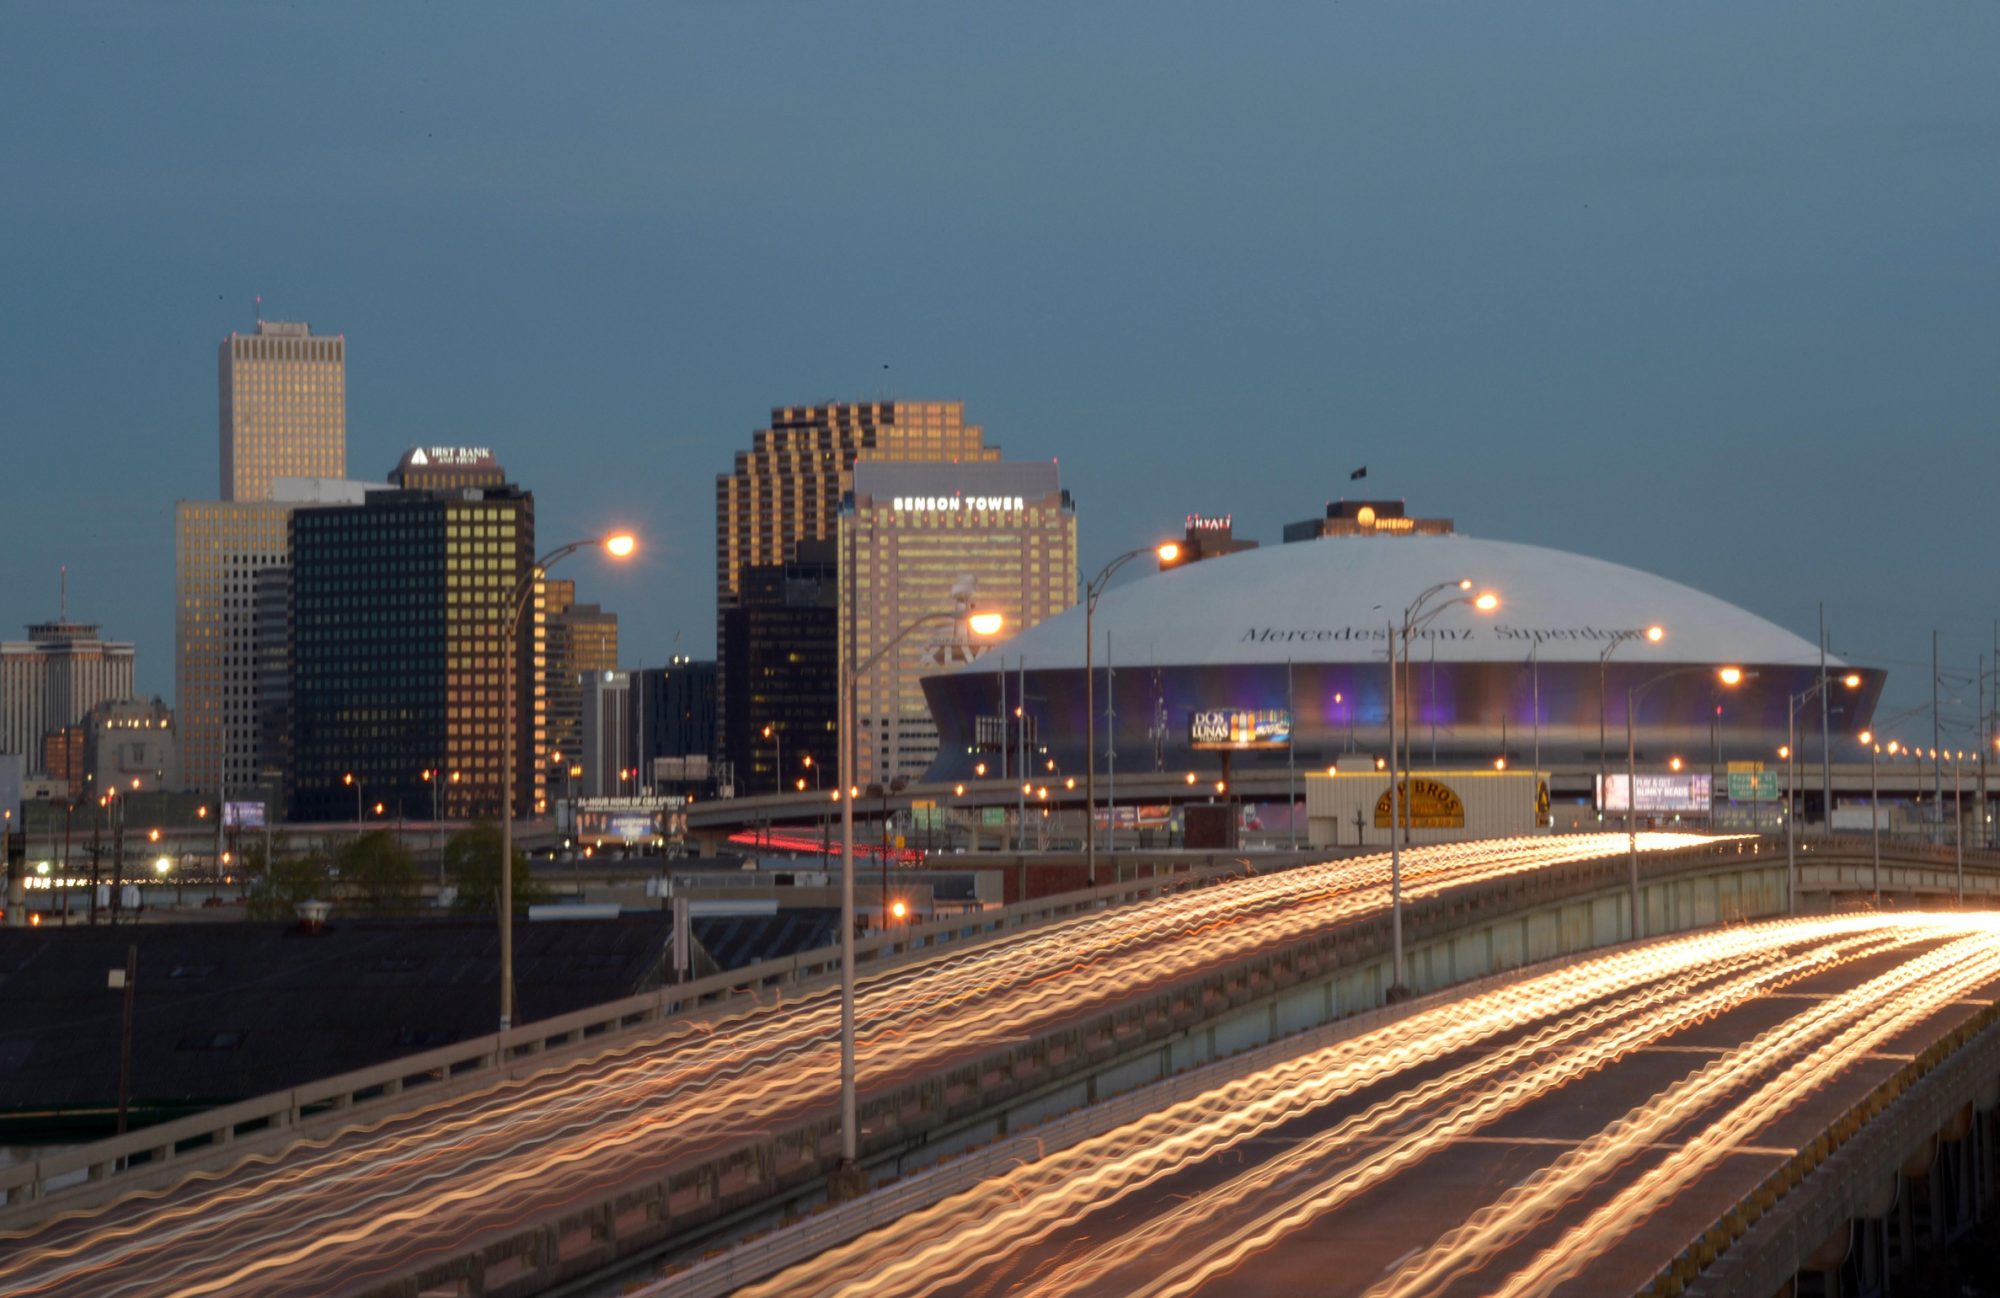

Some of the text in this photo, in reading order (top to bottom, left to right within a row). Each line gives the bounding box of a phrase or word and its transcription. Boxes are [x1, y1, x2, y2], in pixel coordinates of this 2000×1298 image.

[429, 447, 489, 458] IRST BANK
[893, 496, 1024, 512] BENSON TOWER
[1195, 518, 1231, 530] HYATT
[1375, 518, 1415, 530] ENTERGY
[1494, 624, 1653, 644] Superdom
[1195, 711, 1225, 726] DOS
[1192, 723, 1229, 739] LUNAS
[1415, 780, 1459, 815] BROS
[1664, 786, 1689, 797] BEADS
[577, 796, 609, 808] 24-HOUR
[610, 796, 631, 807] HOME
[632, 796, 642, 806] OF
[657, 796, 686, 806] SPORTS
